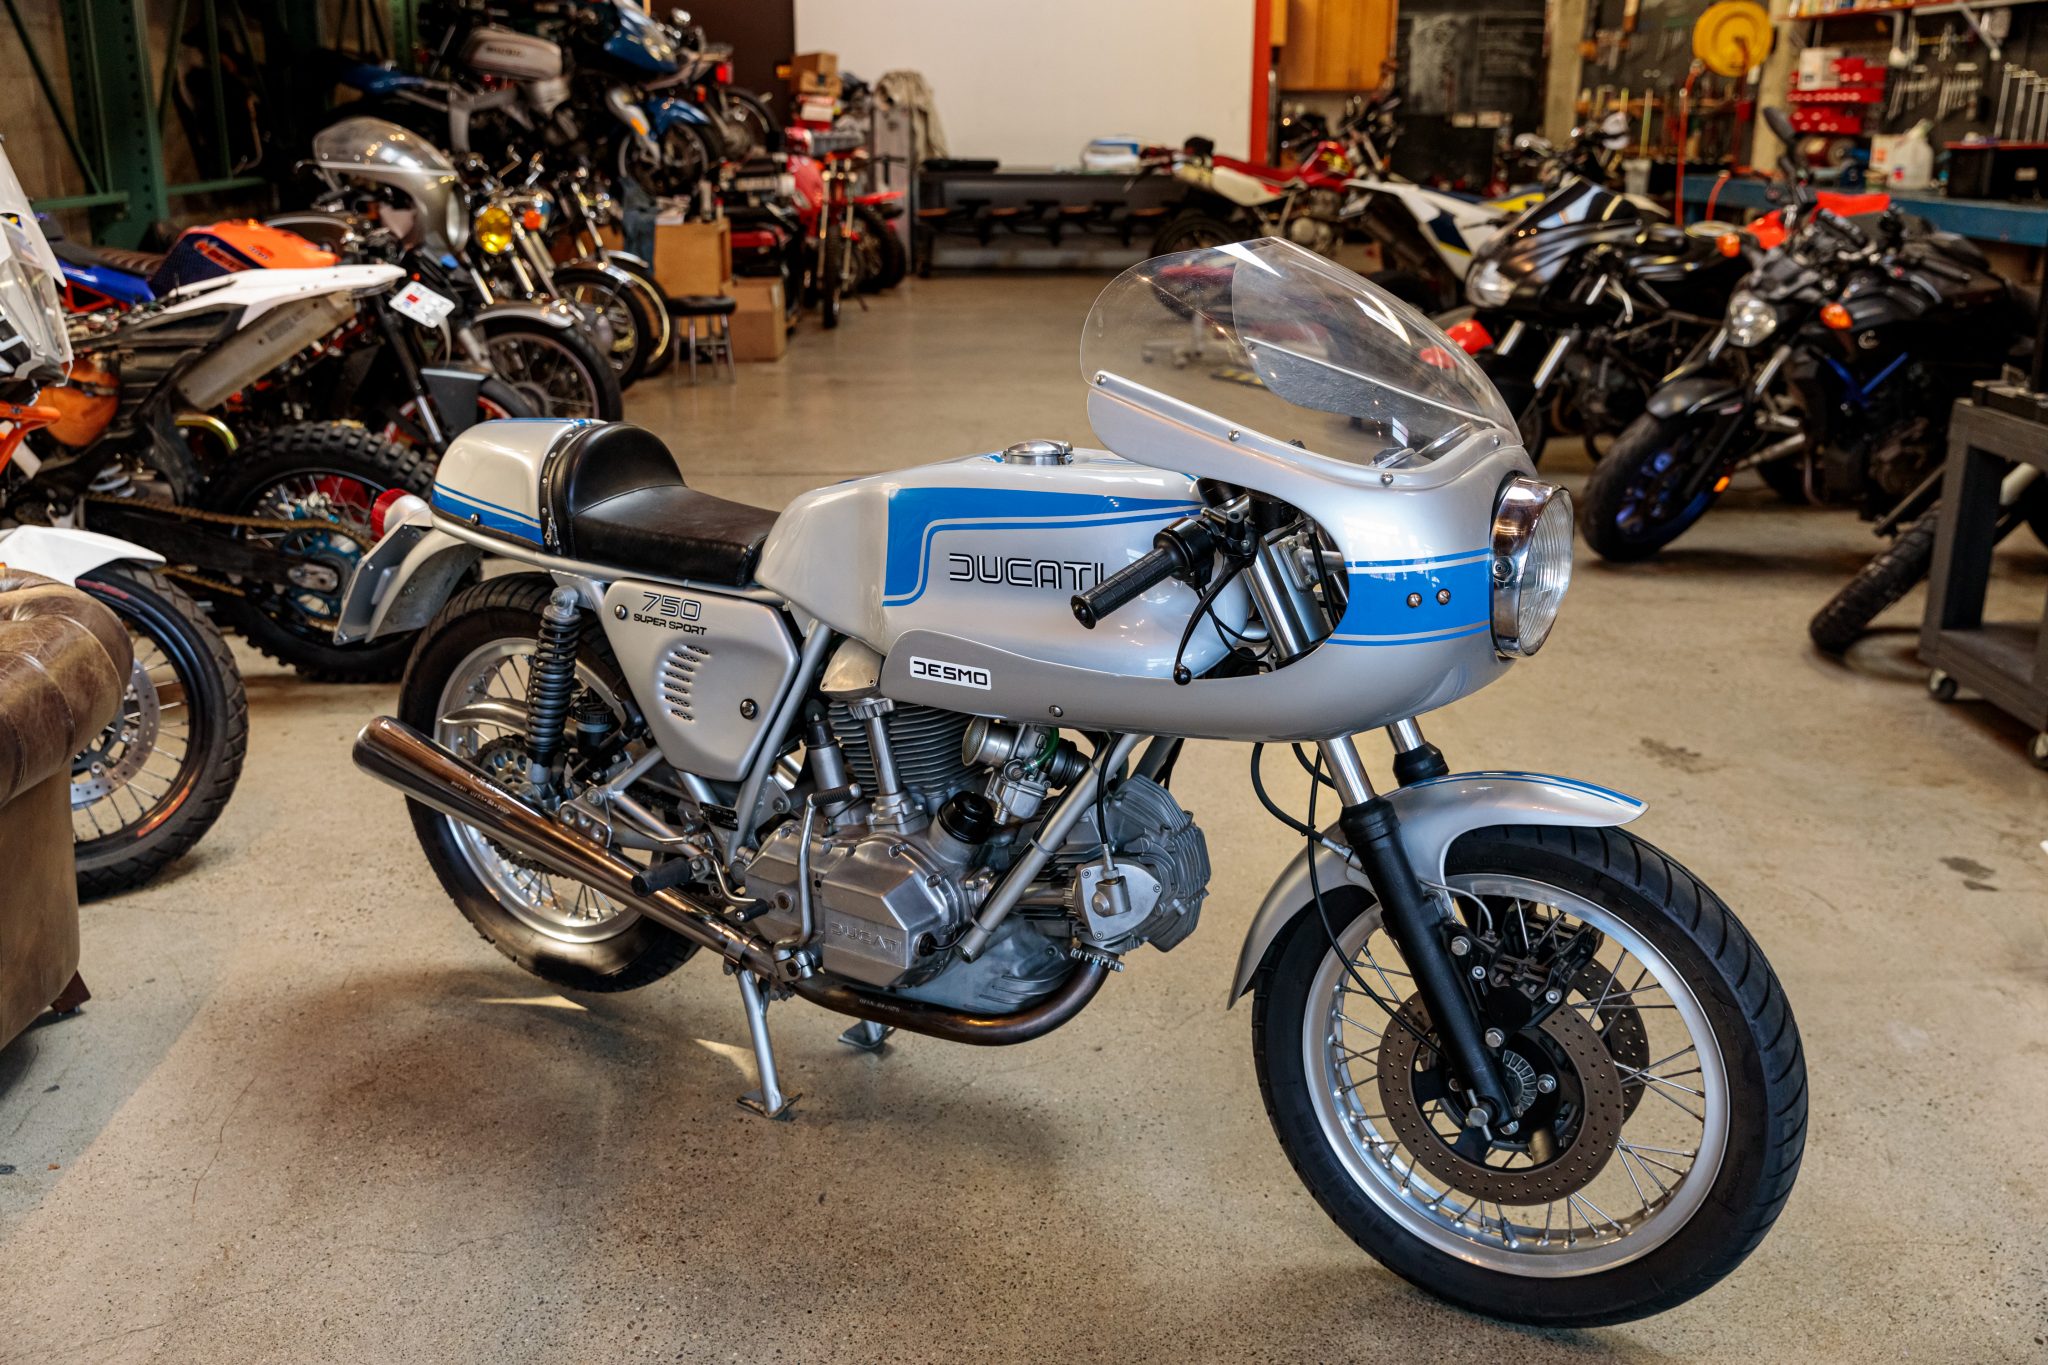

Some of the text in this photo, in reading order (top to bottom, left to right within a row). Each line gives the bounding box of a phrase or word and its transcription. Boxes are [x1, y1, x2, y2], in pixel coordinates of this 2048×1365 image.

[949, 552, 1104, 591] DUCATI
[642, 591, 702, 622] 750
[633, 613, 708, 636] SUPER SPORT
[913, 660, 988, 686] DESMO
[831, 921, 902, 953] DUCATI
